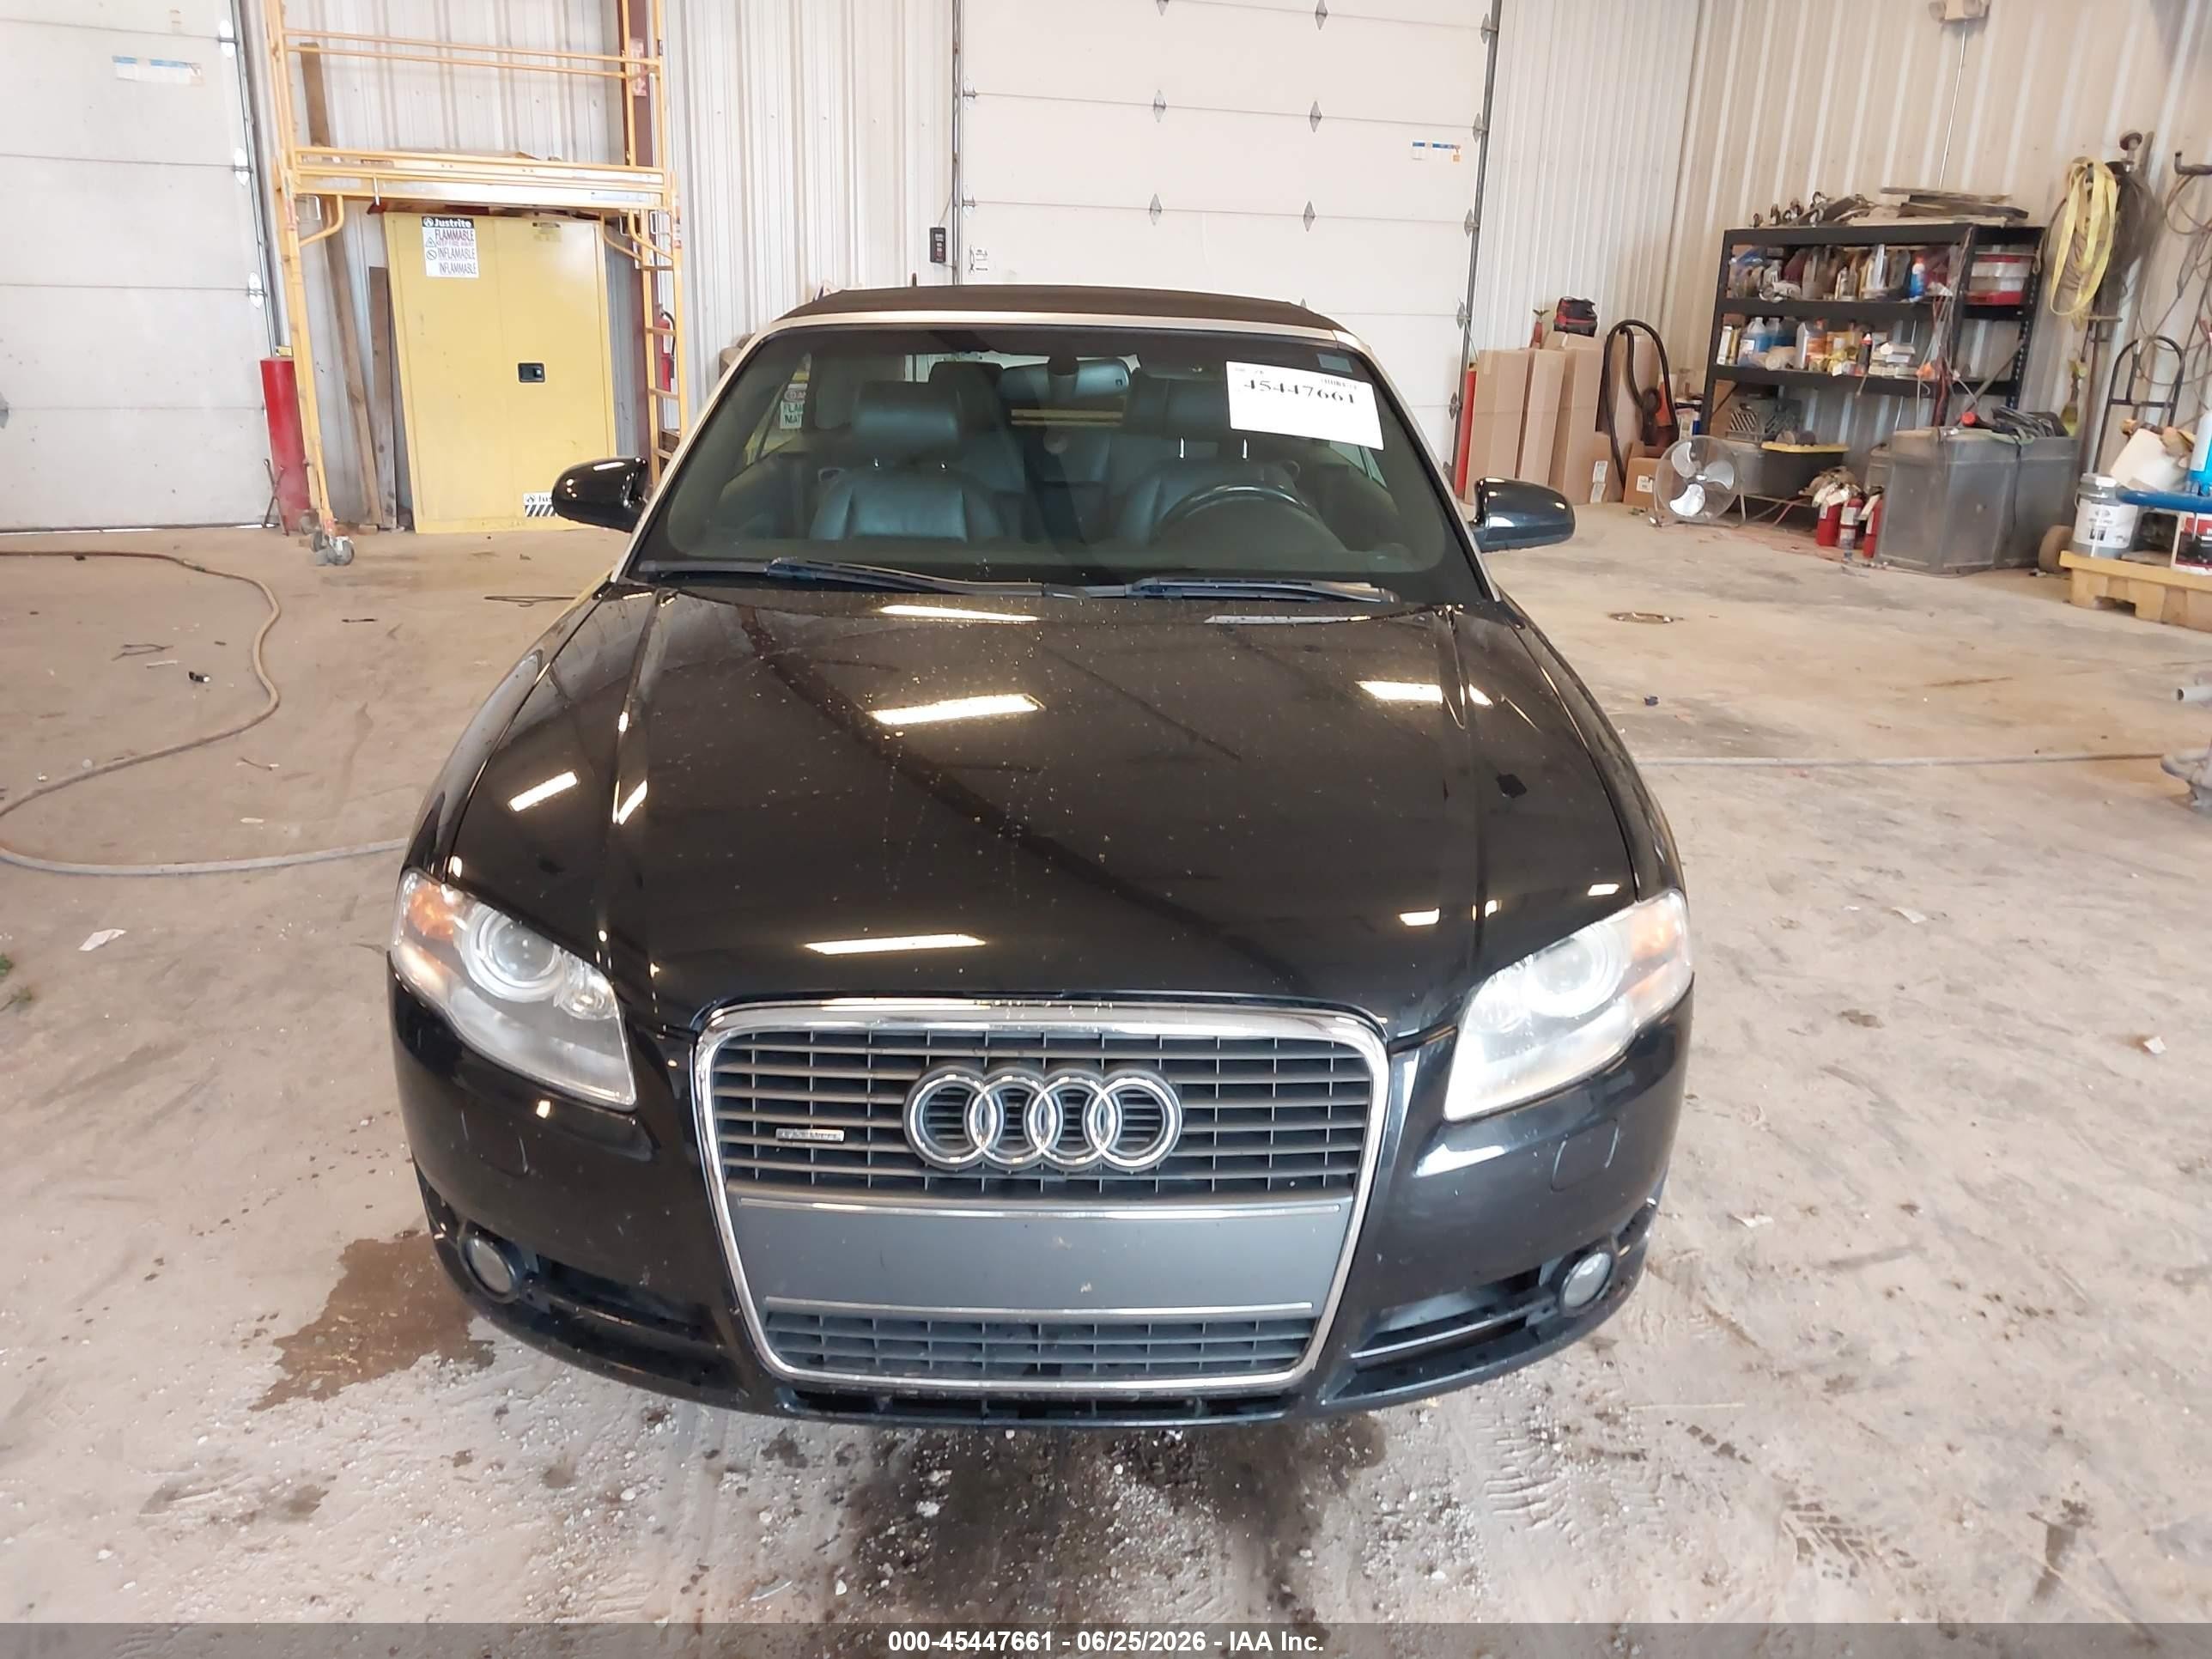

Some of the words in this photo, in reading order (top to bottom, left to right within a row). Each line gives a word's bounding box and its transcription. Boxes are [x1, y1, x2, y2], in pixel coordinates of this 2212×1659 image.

[434, 218, 471, 228] Justrite
[435, 228, 475, 241] FLAMMABLE
[438, 247, 475, 259] INFLAMABLE
[1244, 379, 1354, 404] 45447661
